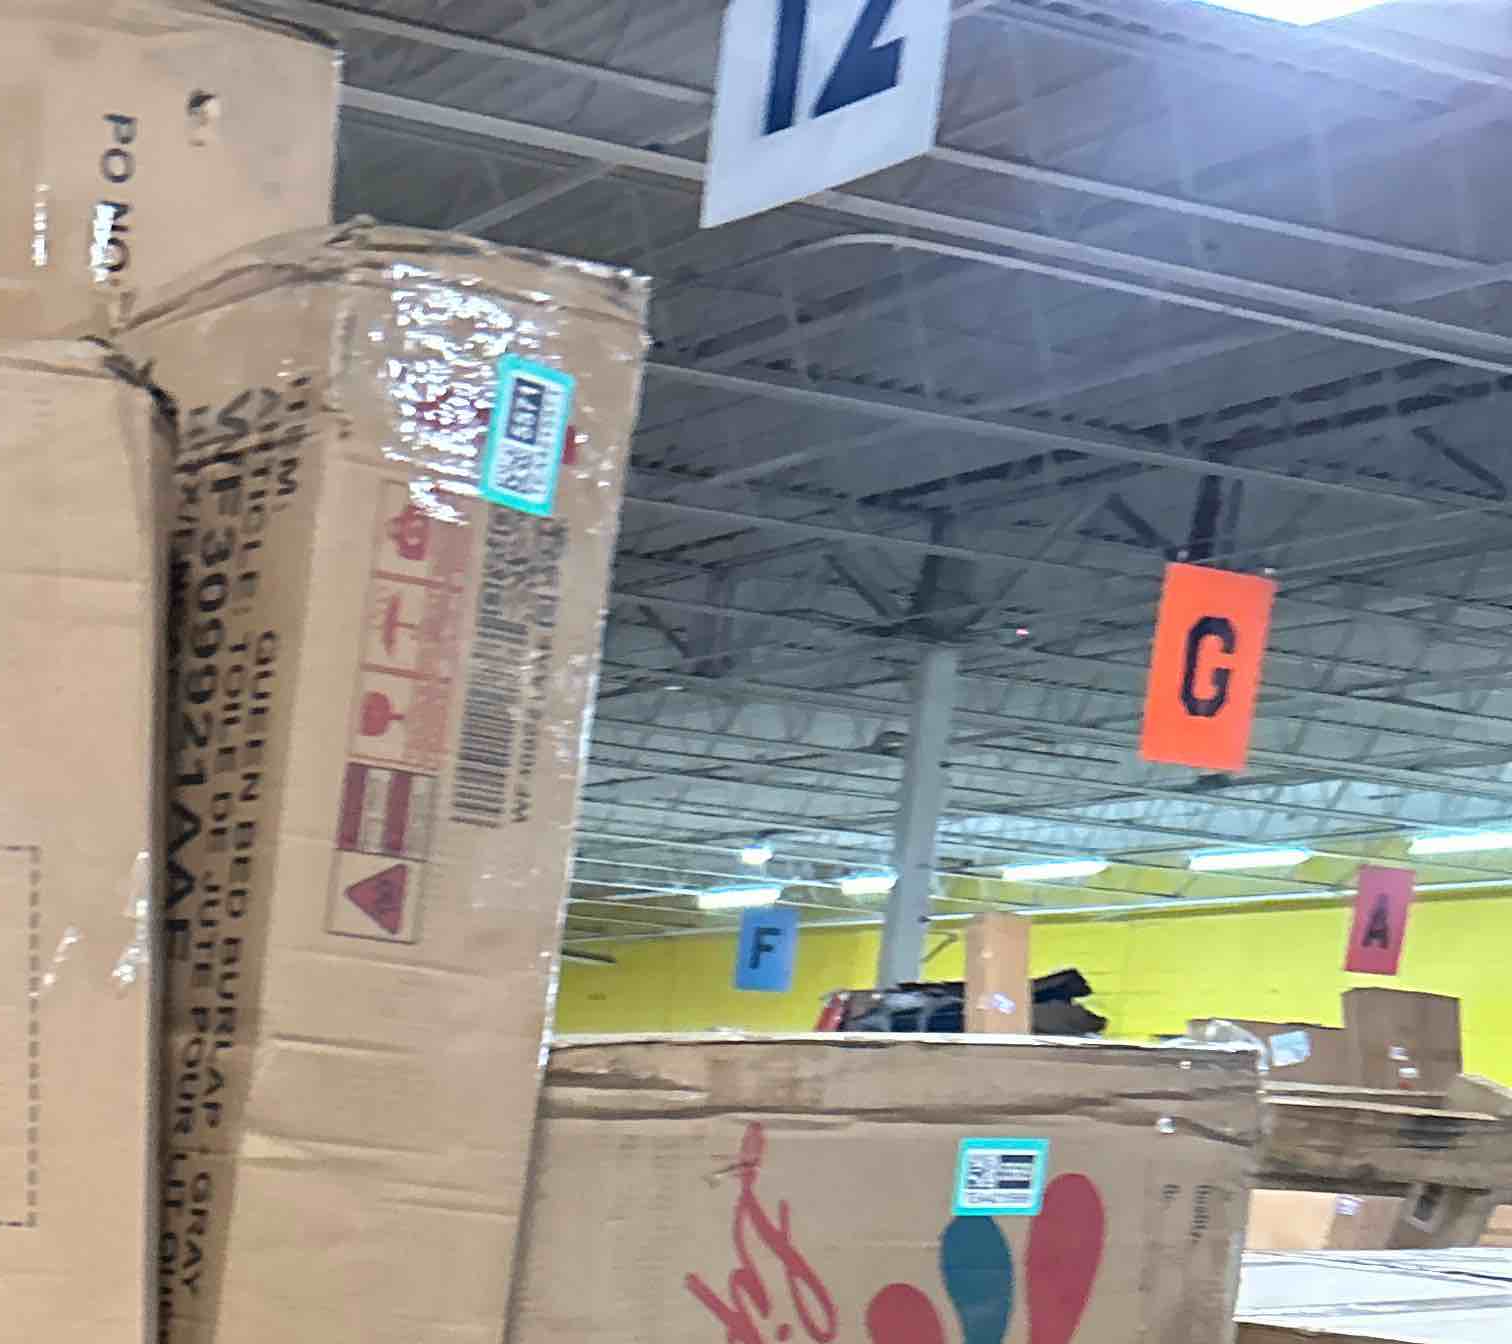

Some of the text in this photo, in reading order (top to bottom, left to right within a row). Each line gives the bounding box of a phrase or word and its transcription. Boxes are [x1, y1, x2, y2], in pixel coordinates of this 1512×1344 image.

[101, 113, 138, 182] PO
[241, 630, 283, 803] QUEEN
[1177, 615, 1238, 718] G
[226, 821, 257, 919] BED
[751, 926, 777, 969] F
[1361, 915, 1393, 951] A
[205, 937, 243, 1130] BURLAP
[181, 1171, 211, 1294] GRAY
